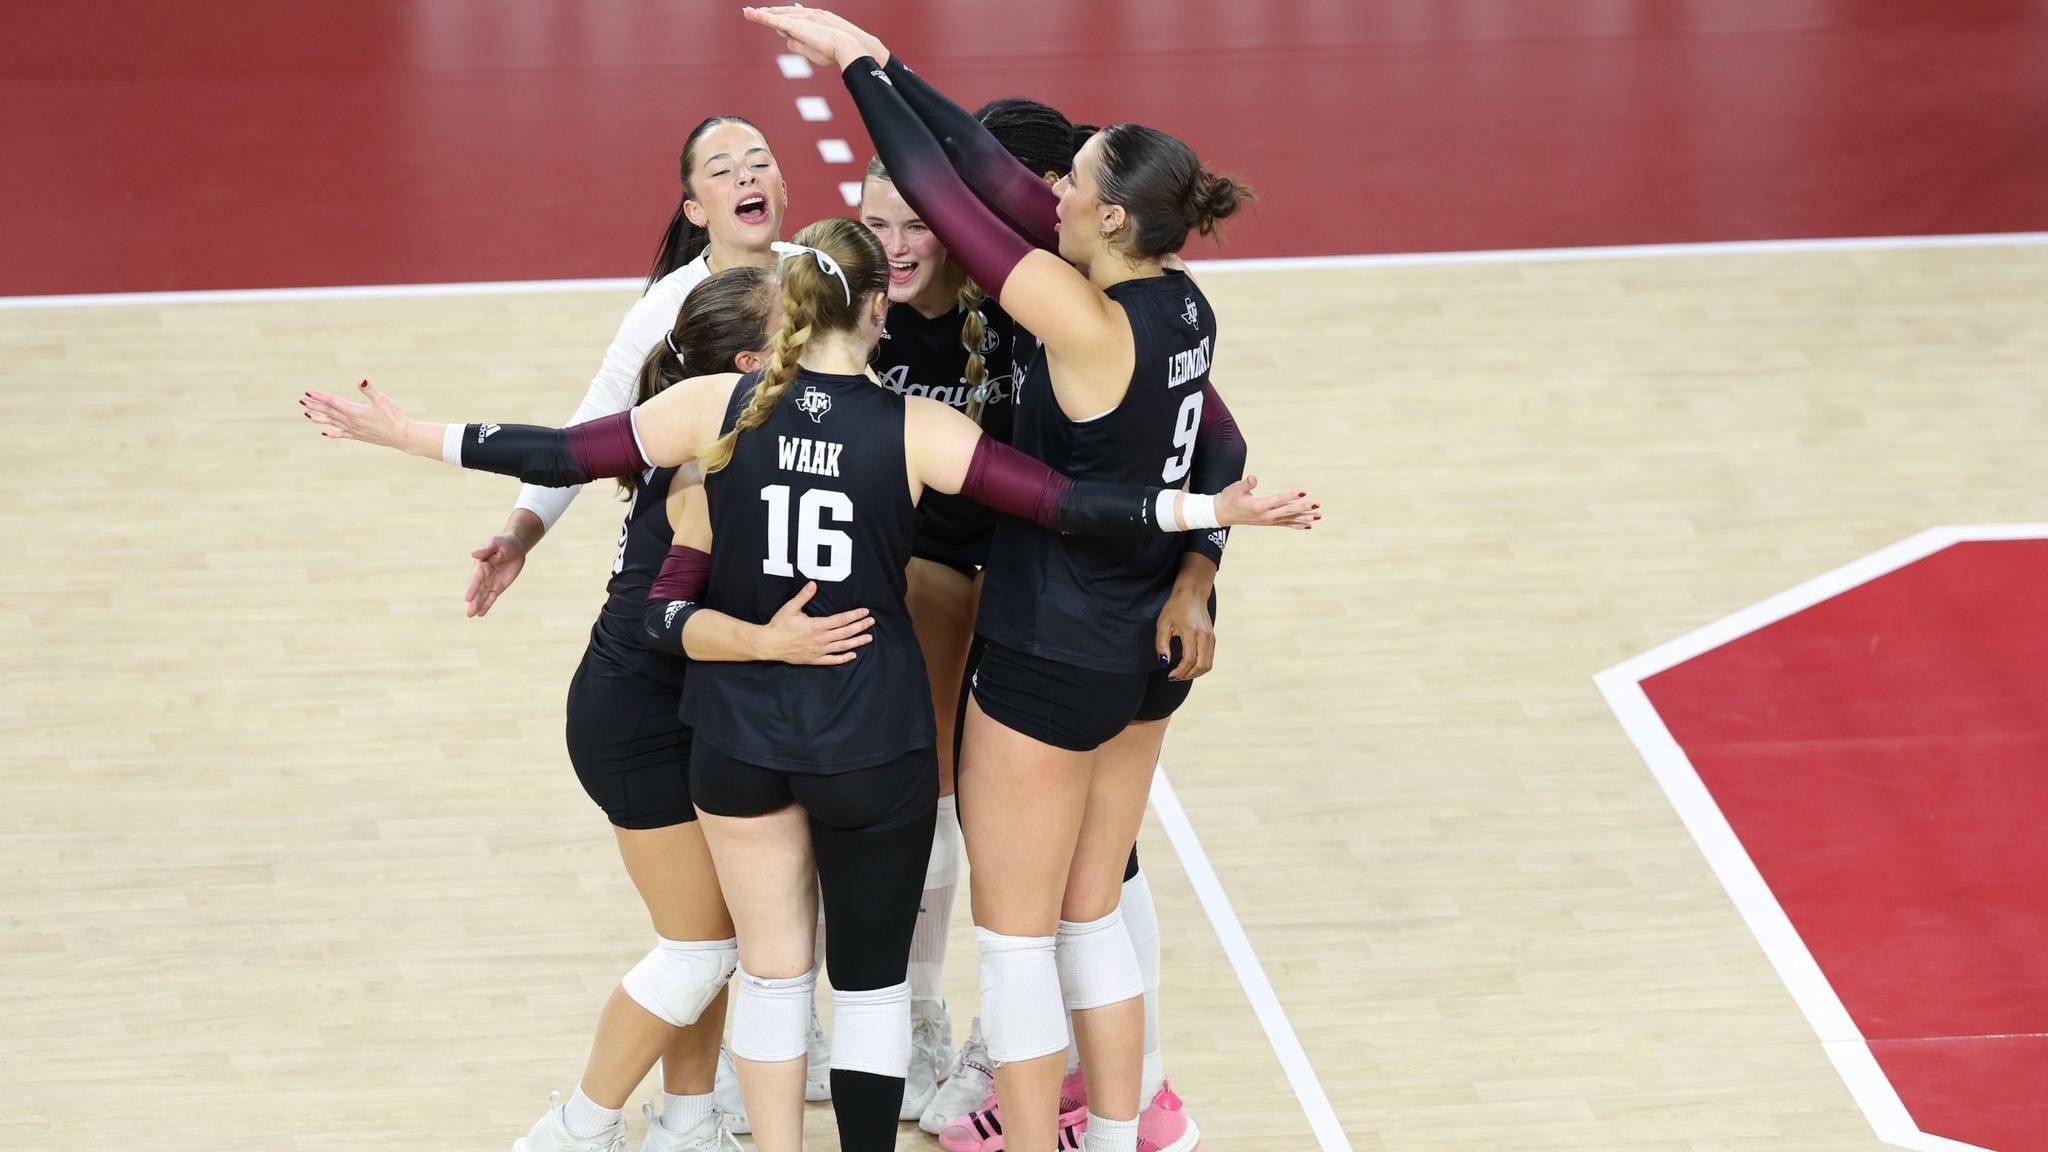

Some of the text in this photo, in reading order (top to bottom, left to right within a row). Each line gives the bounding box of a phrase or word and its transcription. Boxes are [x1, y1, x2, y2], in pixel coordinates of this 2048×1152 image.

[778, 435, 843, 478] WAAK
[1161, 390, 1204, 484] 9
[760, 484, 854, 582] 16
